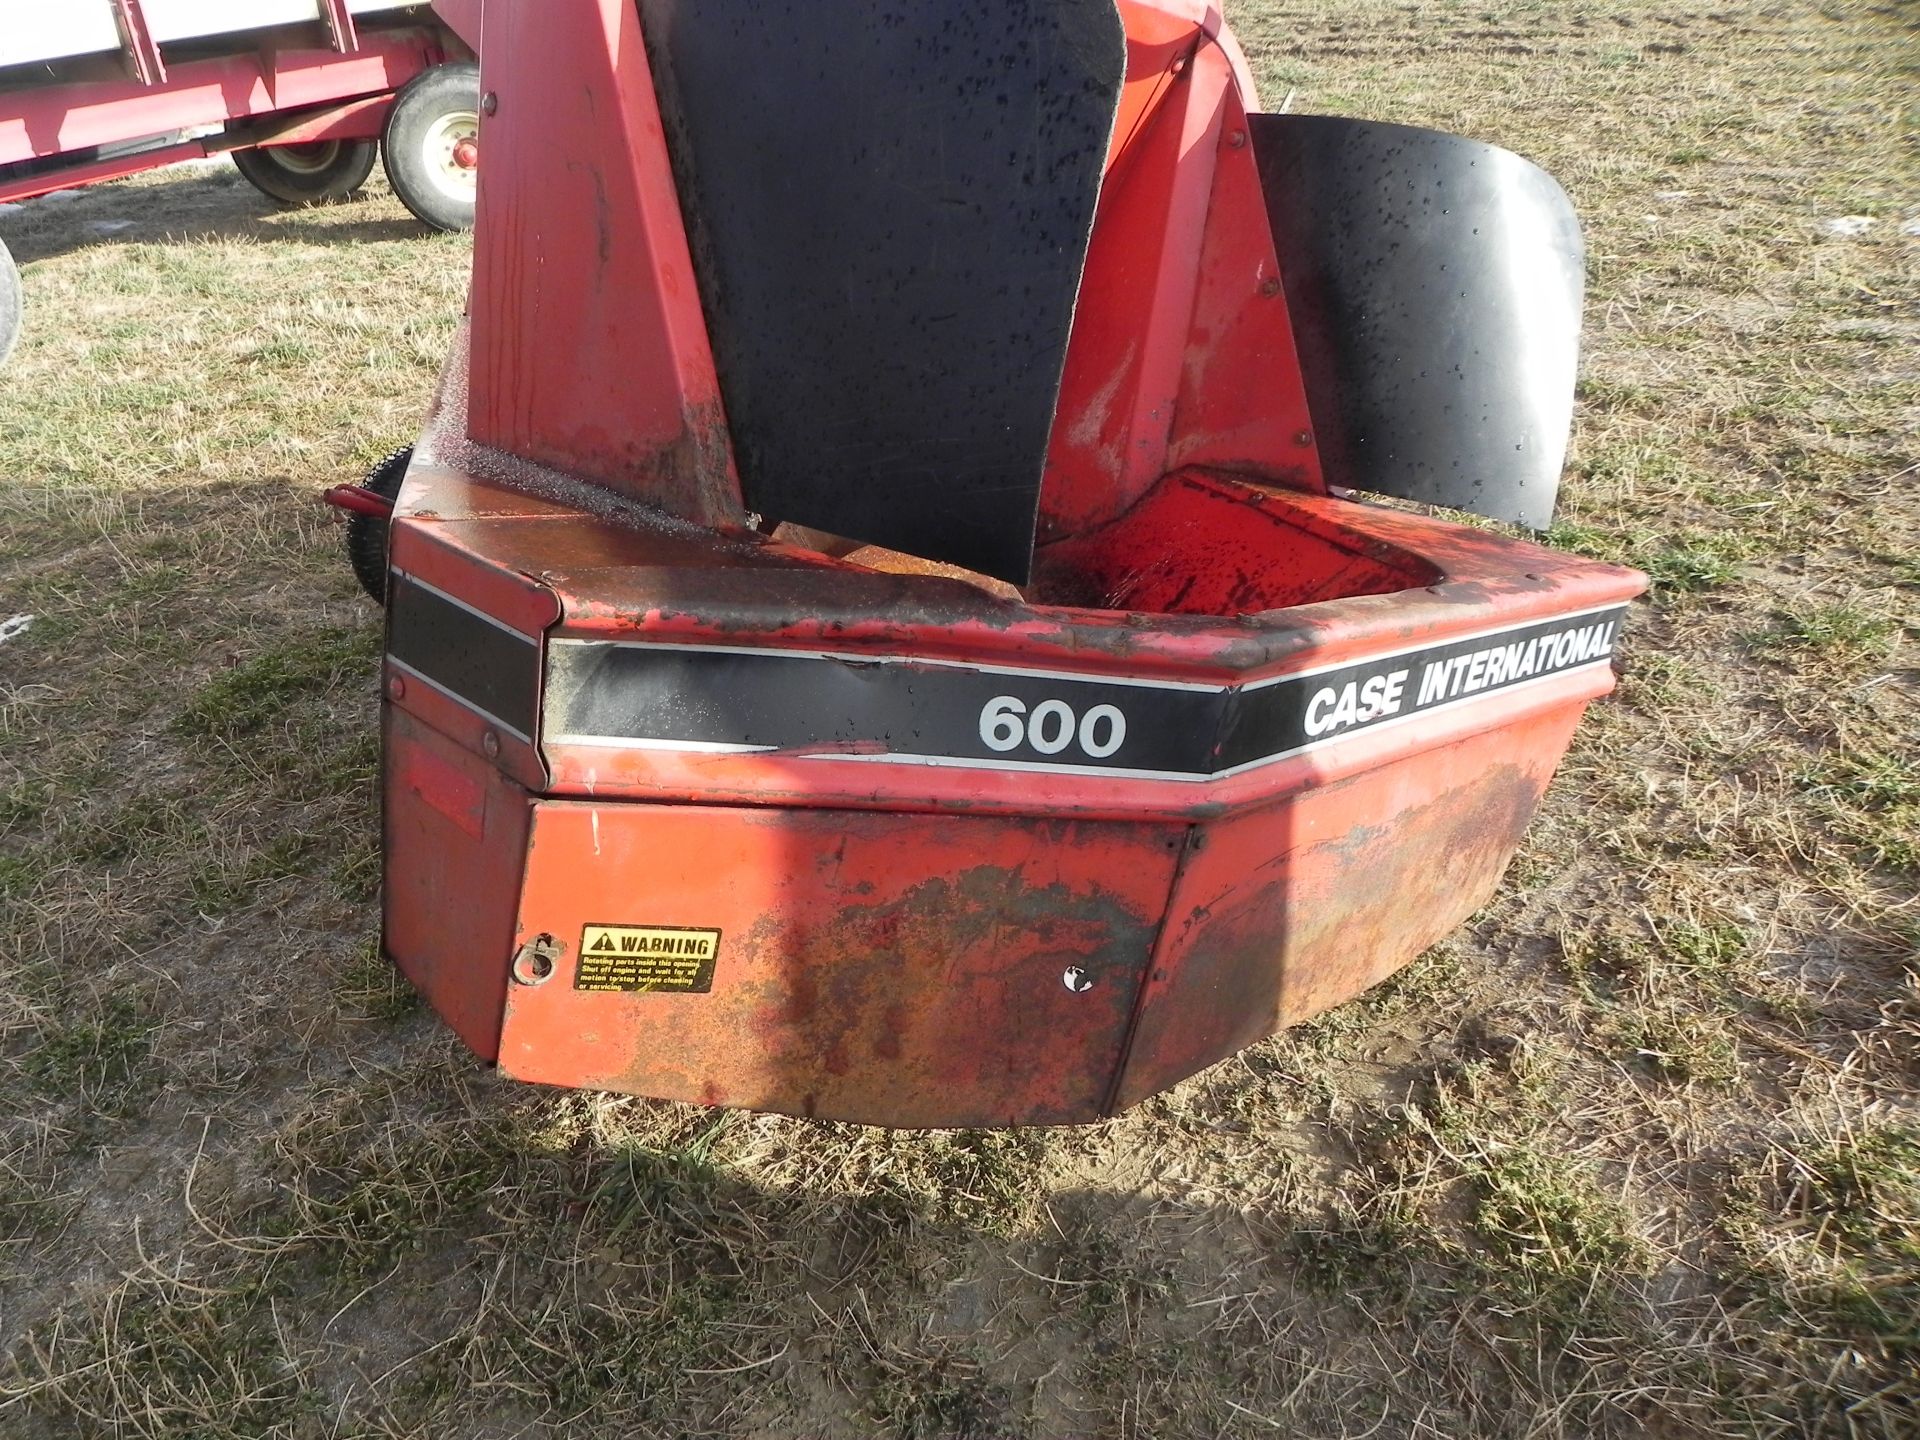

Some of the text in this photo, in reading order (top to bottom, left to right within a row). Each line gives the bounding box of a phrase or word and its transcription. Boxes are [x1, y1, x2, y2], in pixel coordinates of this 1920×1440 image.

[1304, 621, 1613, 738] CASE INTERNATIONAL
[979, 695, 1127, 759] 600
[621, 936, 709, 954] WARNING
[583, 957, 613, 966] Rotating
[613, 967, 636, 975] engine
[619, 976, 635, 984] stop
[664, 977, 693, 985] cleaning
